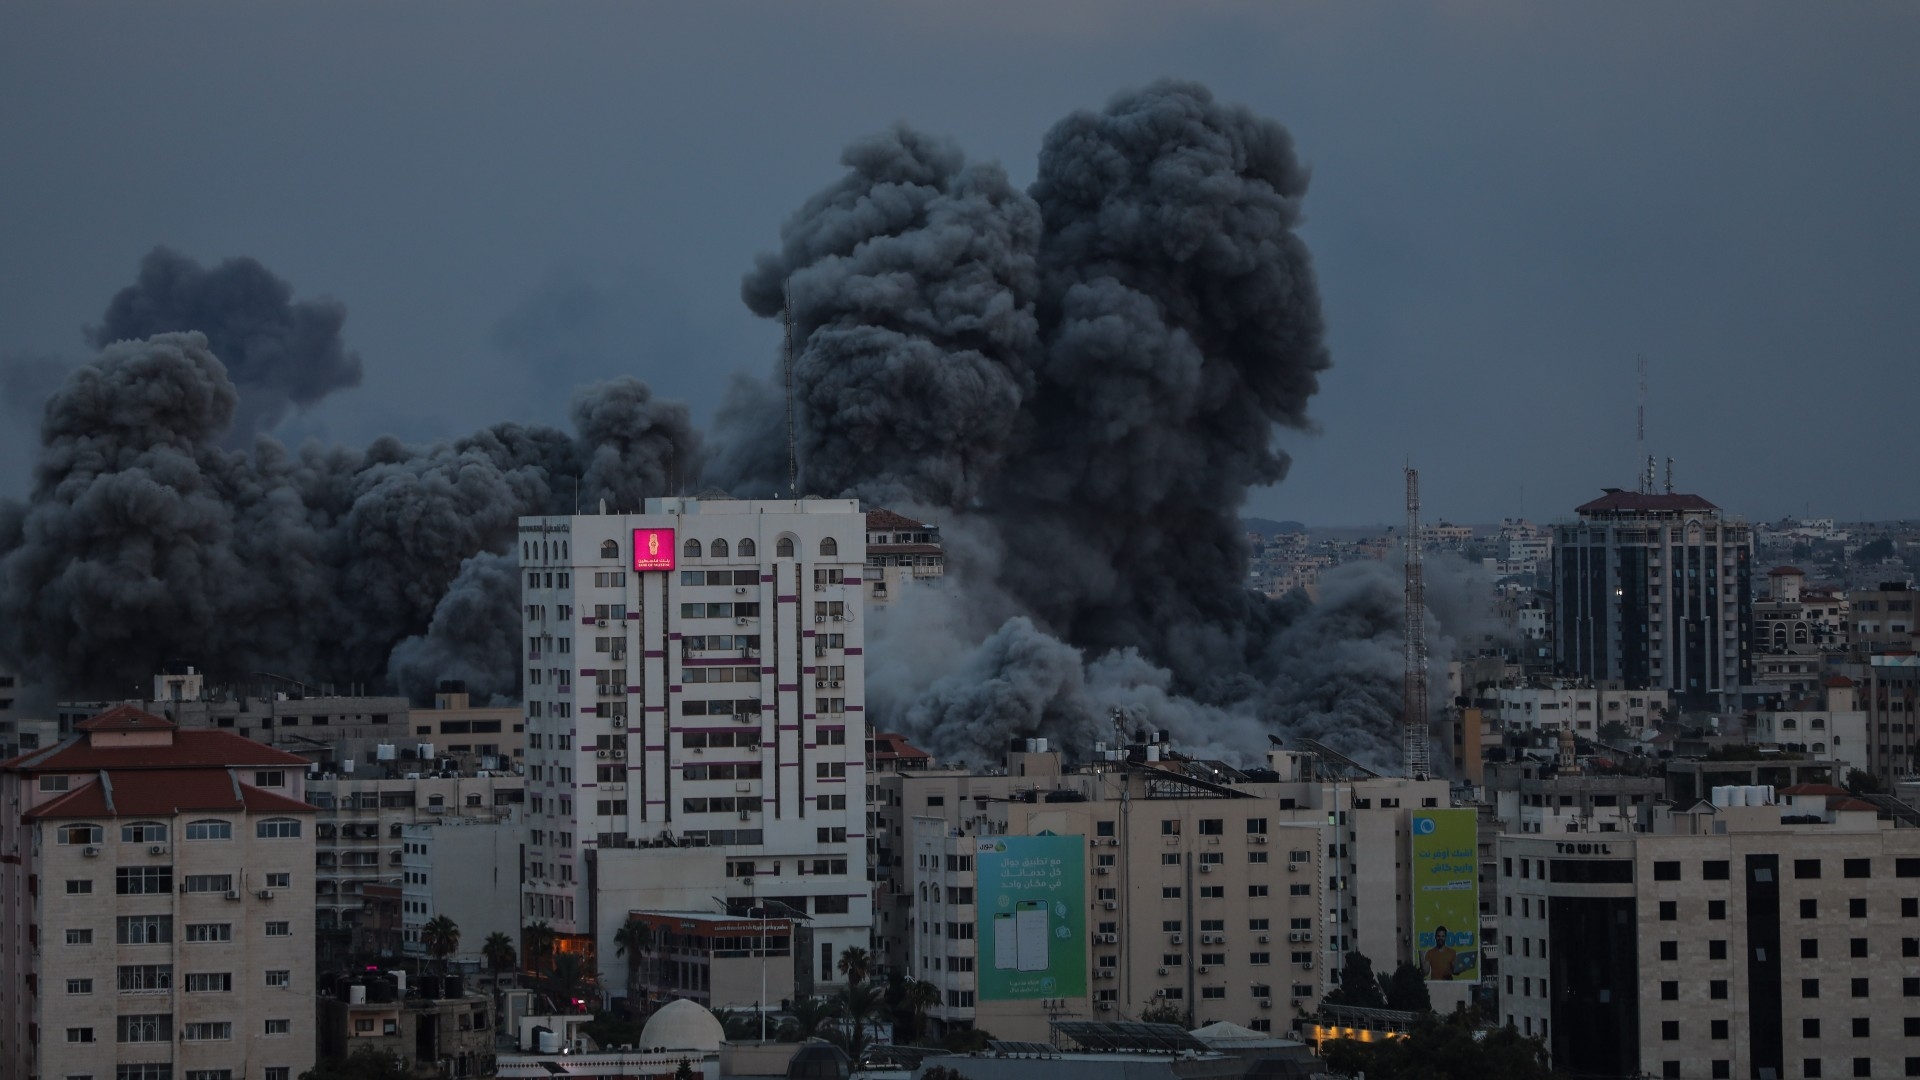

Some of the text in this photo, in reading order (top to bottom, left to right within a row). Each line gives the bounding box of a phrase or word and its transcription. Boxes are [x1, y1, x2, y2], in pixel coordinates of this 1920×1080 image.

[1419, 848, 1473, 859] اشبك أوفر نت
[1556, 843, 1611, 854] TAWIL
[1001, 857, 1061, 867] مع تطبيق جوال
[1049, 869, 1061, 877] كل
[1431, 863, 1473, 873] واربح كاش
[1001, 879, 1061, 891] في مكان واحد
